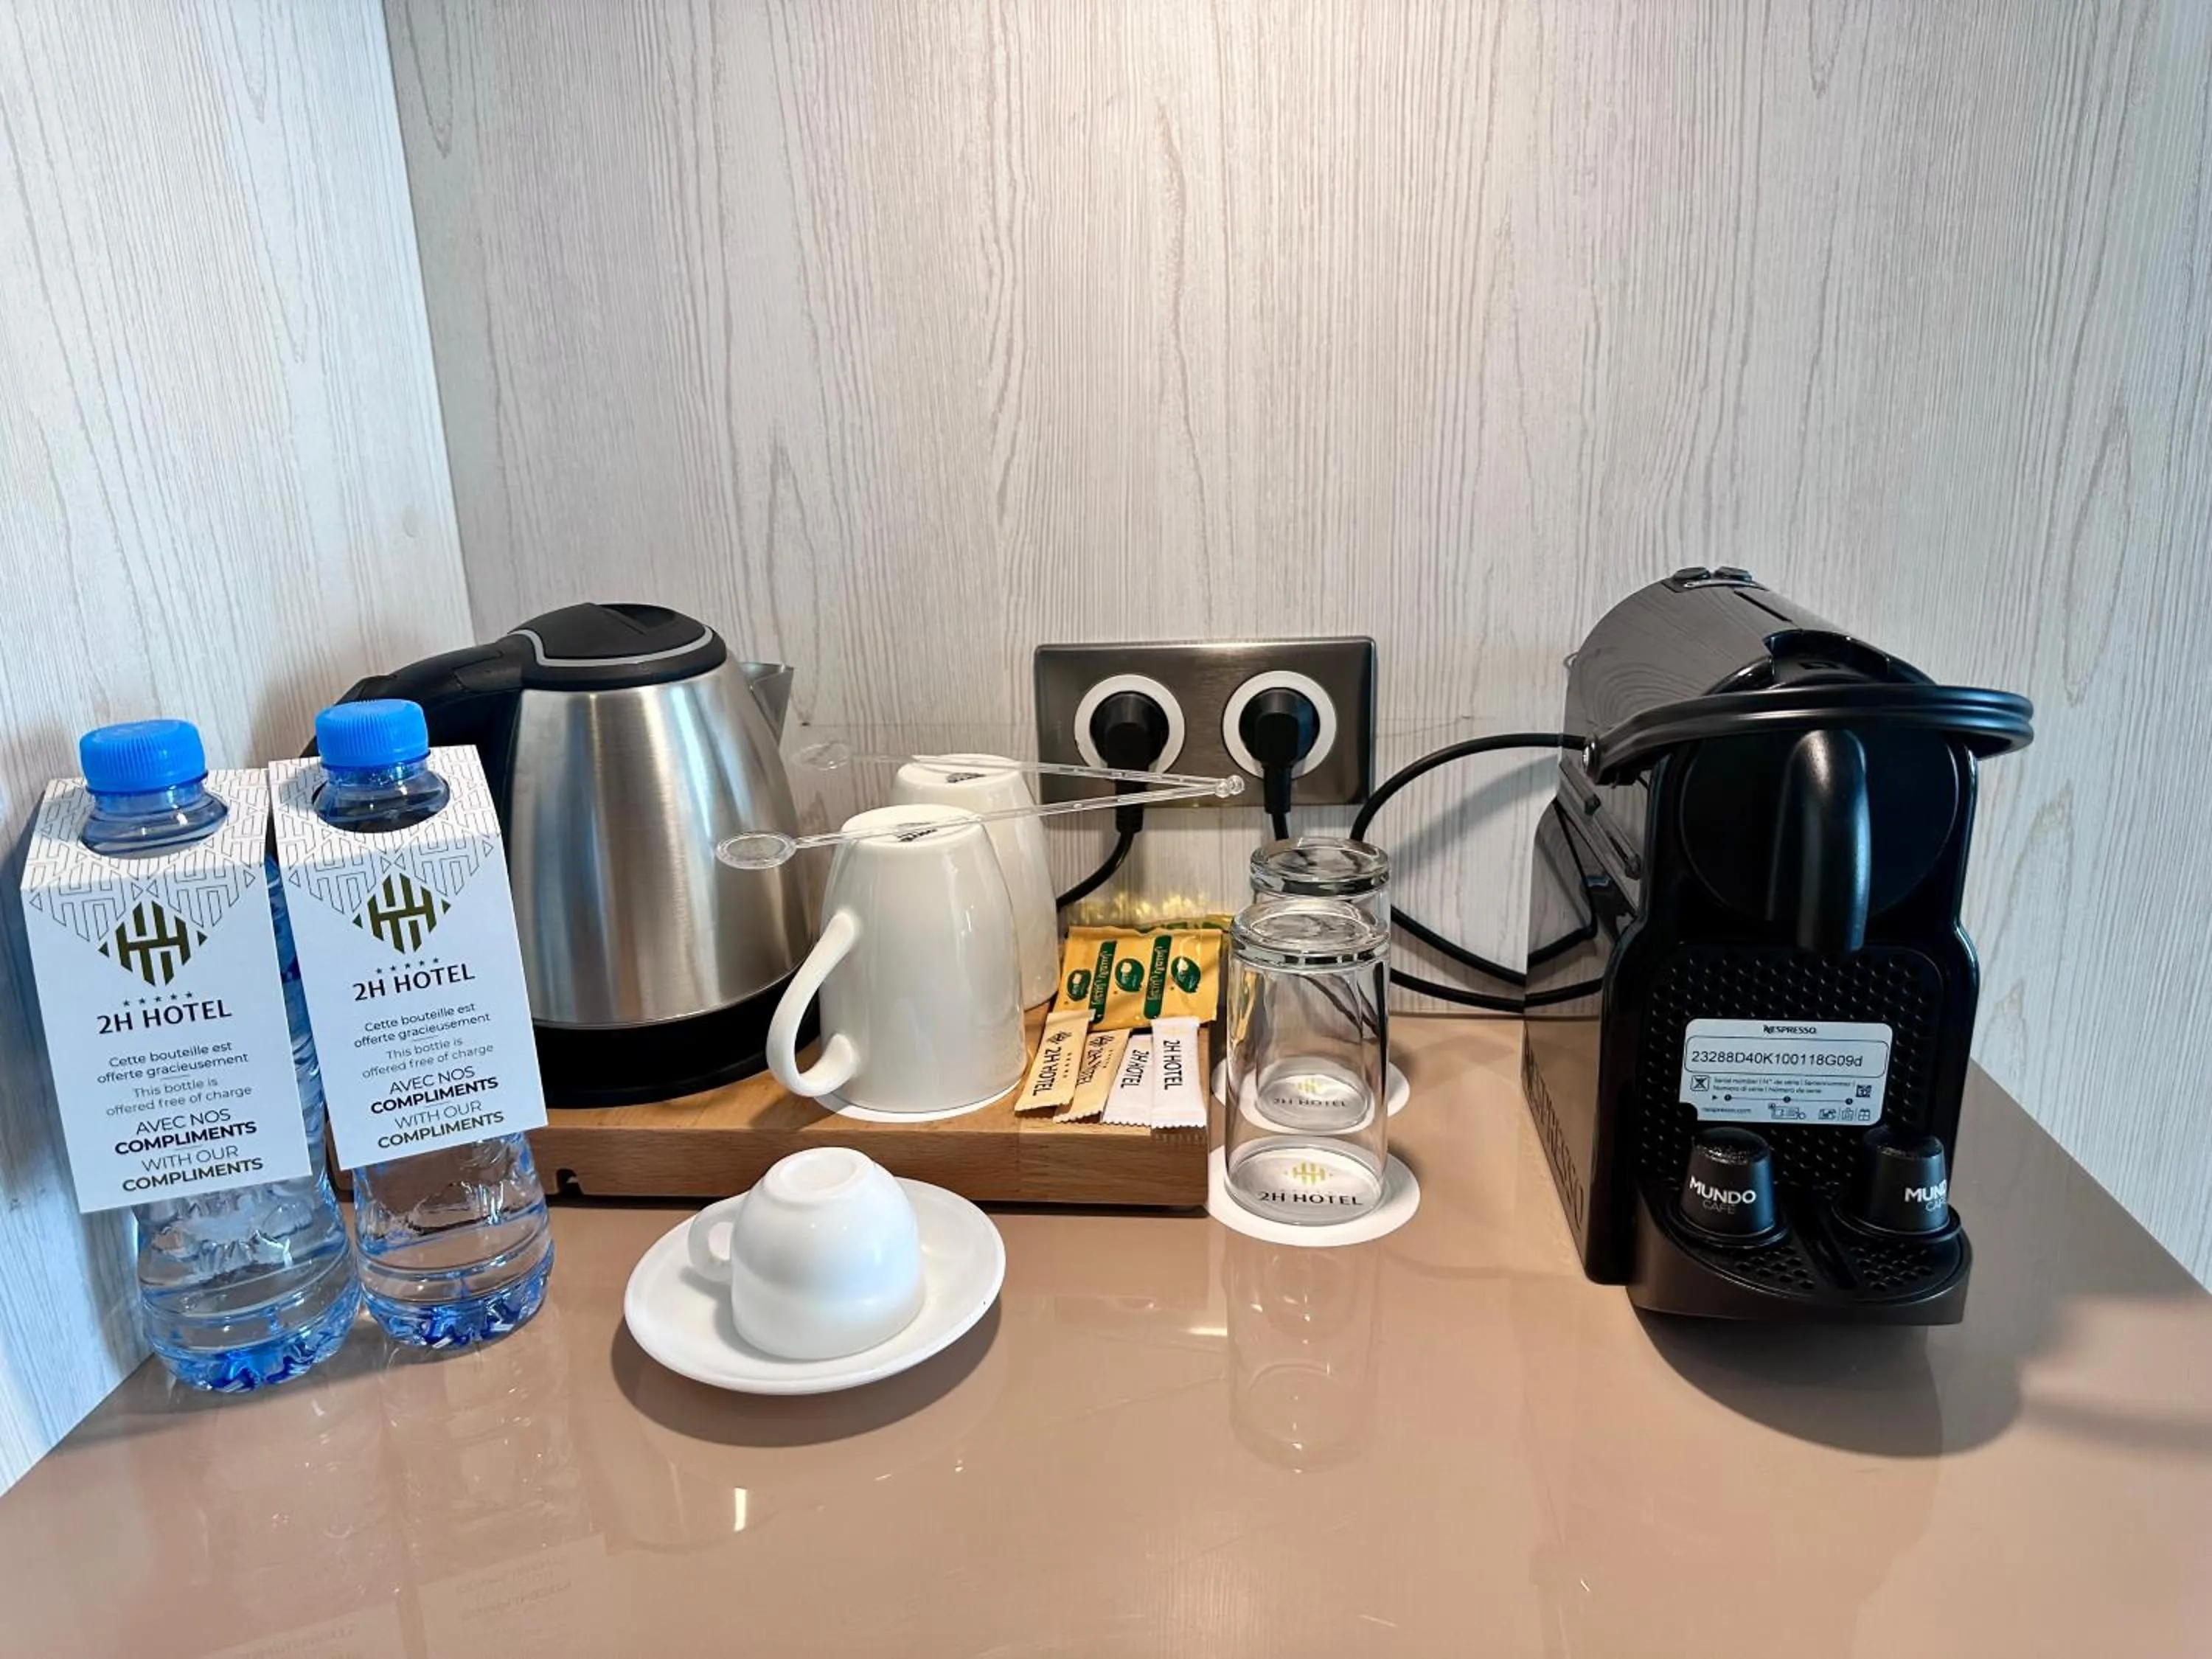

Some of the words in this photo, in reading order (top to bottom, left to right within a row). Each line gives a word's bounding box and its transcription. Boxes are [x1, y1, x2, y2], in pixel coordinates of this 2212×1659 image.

[352, 978, 386, 1001] 2H
[394, 963, 476, 993] HOTEL
[97, 1012, 133, 1034] 2H
[142, 999, 232, 1028] HOTEL
[354, 1033, 395, 1048] offerte
[398, 1013, 491, 1040] gracieusement
[365, 1019, 398, 1032] Cette
[401, 1007, 454, 1026] bouteille
[458, 1003, 476, 1013] est
[1763, 1024, 1817, 1034] NESPRESSO
[108, 1053, 146, 1067] Cette
[150, 1045, 209, 1062] bouteille
[212, 1042, 232, 1053] est
[386, 1048, 411, 1060] This
[415, 1040, 451, 1054] bottle
[453, 1037, 463, 1046] is
[1043, 1046, 1062, 1064] 2H
[1130, 1049, 1150, 1063] 2H
[1163, 1039, 1181, 1053] 2H
[1691, 1051, 1863, 1067] 23288D40K100118G09d
[97, 1068, 143, 1084] offerte
[147, 1053, 248, 1078] gracieusement
[362, 1062, 406, 1079] offered
[409, 1057, 434, 1068] free
[437, 1053, 449, 1063] of
[452, 1044, 494, 1060] charge
[1120, 1062, 1144, 1088] HOTEL
[1164, 1054, 1183, 1091] HOTEL
[133, 1086, 161, 1098] This
[164, 1080, 205, 1093] bottle
[207, 1077, 218, 1087] is
[389, 1074, 434, 1095] AVEC
[438, 1065, 476, 1084] NOS
[1032, 1063, 1060, 1096] HOTEL
[106, 1099, 155, 1116] offered
[159, 1096, 185, 1108] free
[189, 1092, 202, 1104] of
[206, 1086, 253, 1103] charge
[371, 1077, 499, 1114] COMPLIMENTS
[1298, 1098, 1346, 1107] HOTEL
[136, 1116, 185, 1135] AVEC
[189, 1108, 231, 1126] NOS
[394, 1109, 440, 1129] WITH
[443, 1099, 482, 1119] OUR
[115, 1121, 257, 1155] COMPLIMENTS
[378, 1111, 504, 1149] COMPLIMENTS
[142, 1152, 192, 1172] WITH
[196, 1145, 239, 1163] OUR
[122, 1158, 263, 1192] COMPLIMENTS
[1689, 1175, 1757, 1204] MUNDO
[1258, 1191, 1286, 1203] 2H
[1293, 1192, 1363, 1206] HOTEL
